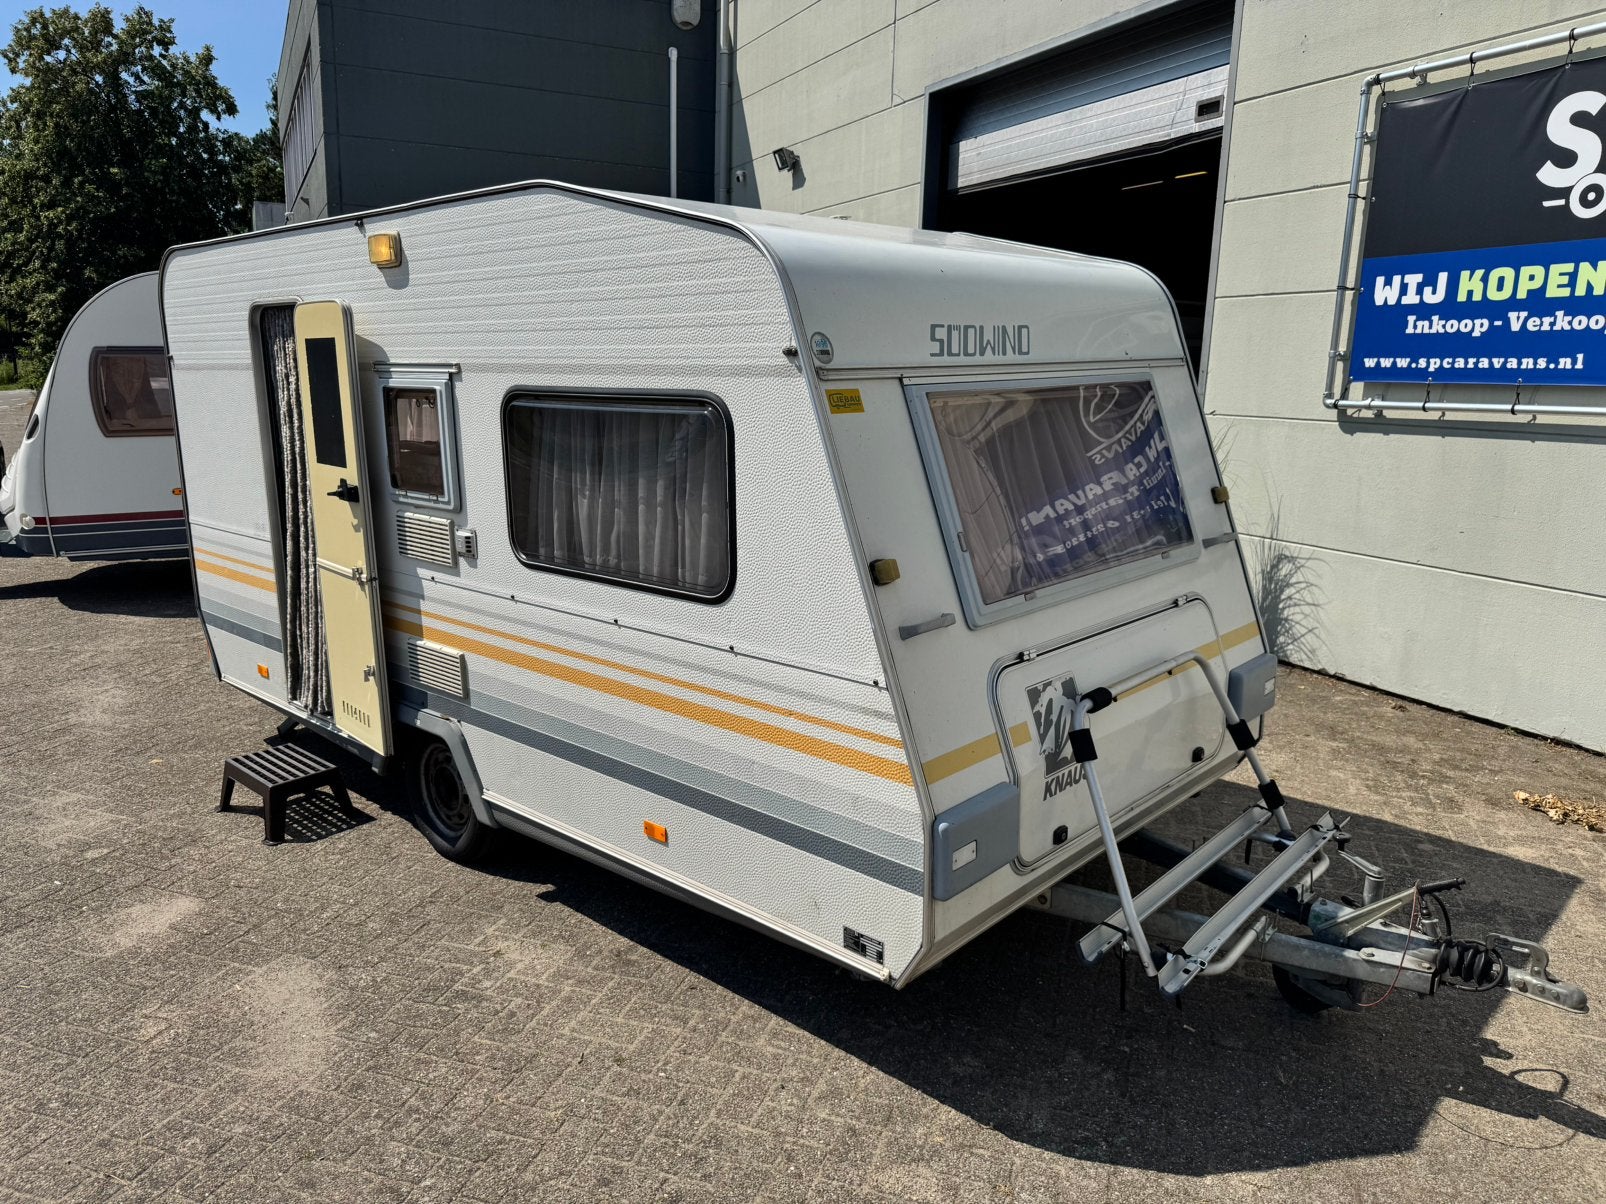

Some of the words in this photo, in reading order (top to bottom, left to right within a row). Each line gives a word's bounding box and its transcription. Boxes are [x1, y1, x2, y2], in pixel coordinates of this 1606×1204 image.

[1374, 272, 1448, 306] WIJ
[1457, 260, 1606, 302] KOPEN
[1405, 315, 1489, 337] Inkoop
[1507, 310, 1606, 335] Verkoo
[930, 324, 1030, 357] SÜDWIND
[1363, 353, 1584, 372] www.spcaravans.nl
[831, 394, 862, 403] LIEBAU
